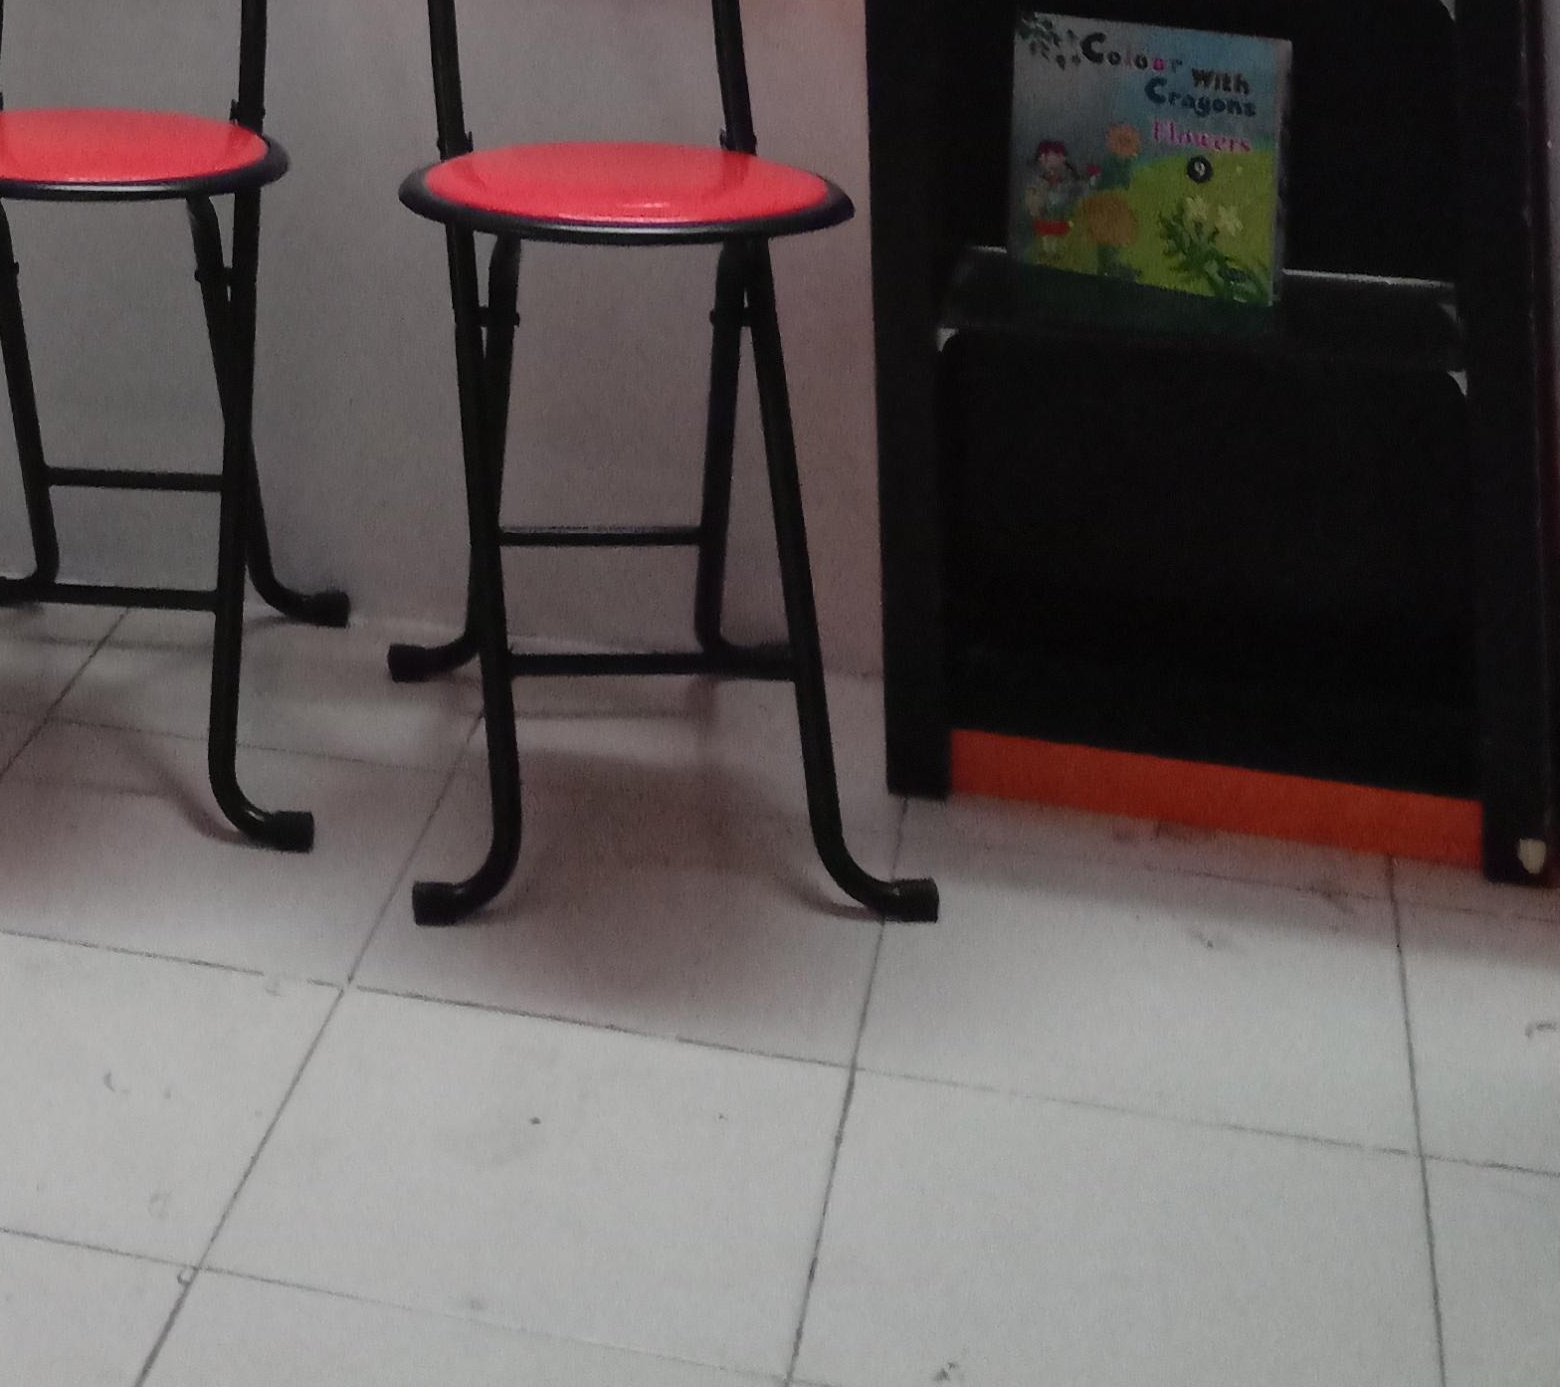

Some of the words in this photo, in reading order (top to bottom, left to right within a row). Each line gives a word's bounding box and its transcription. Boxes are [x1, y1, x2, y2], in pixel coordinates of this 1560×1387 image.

[1080, 32, 1182, 74] Colour
[1143, 77, 1257, 117] Crayons
[1151, 119, 1252, 154] Flowers
[1193, 161, 1206, 178] 9
